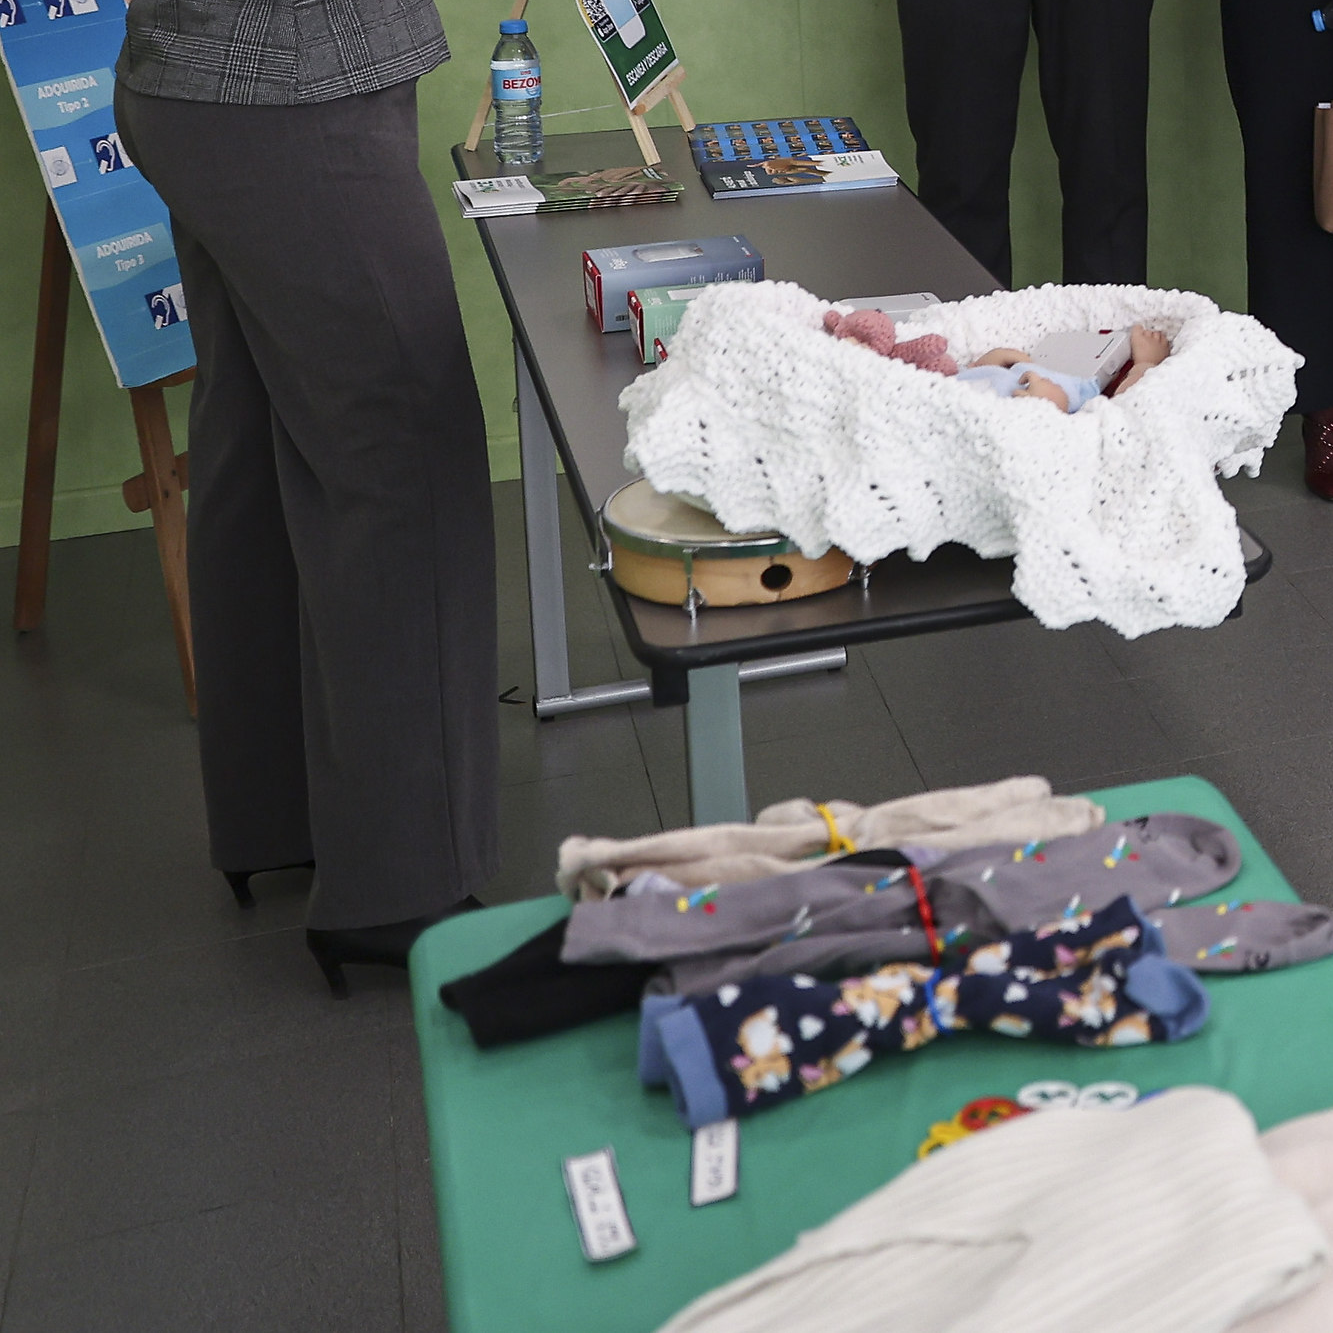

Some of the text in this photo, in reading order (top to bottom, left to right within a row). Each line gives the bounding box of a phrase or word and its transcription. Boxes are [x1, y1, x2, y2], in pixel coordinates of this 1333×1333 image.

[37, 75, 98, 100] ADQUIRIDA
[56, 97, 90, 114] Tipo 2
[96, 231, 153, 259] ADQUIRIDA
[114, 254, 145, 273] Tipo 3
